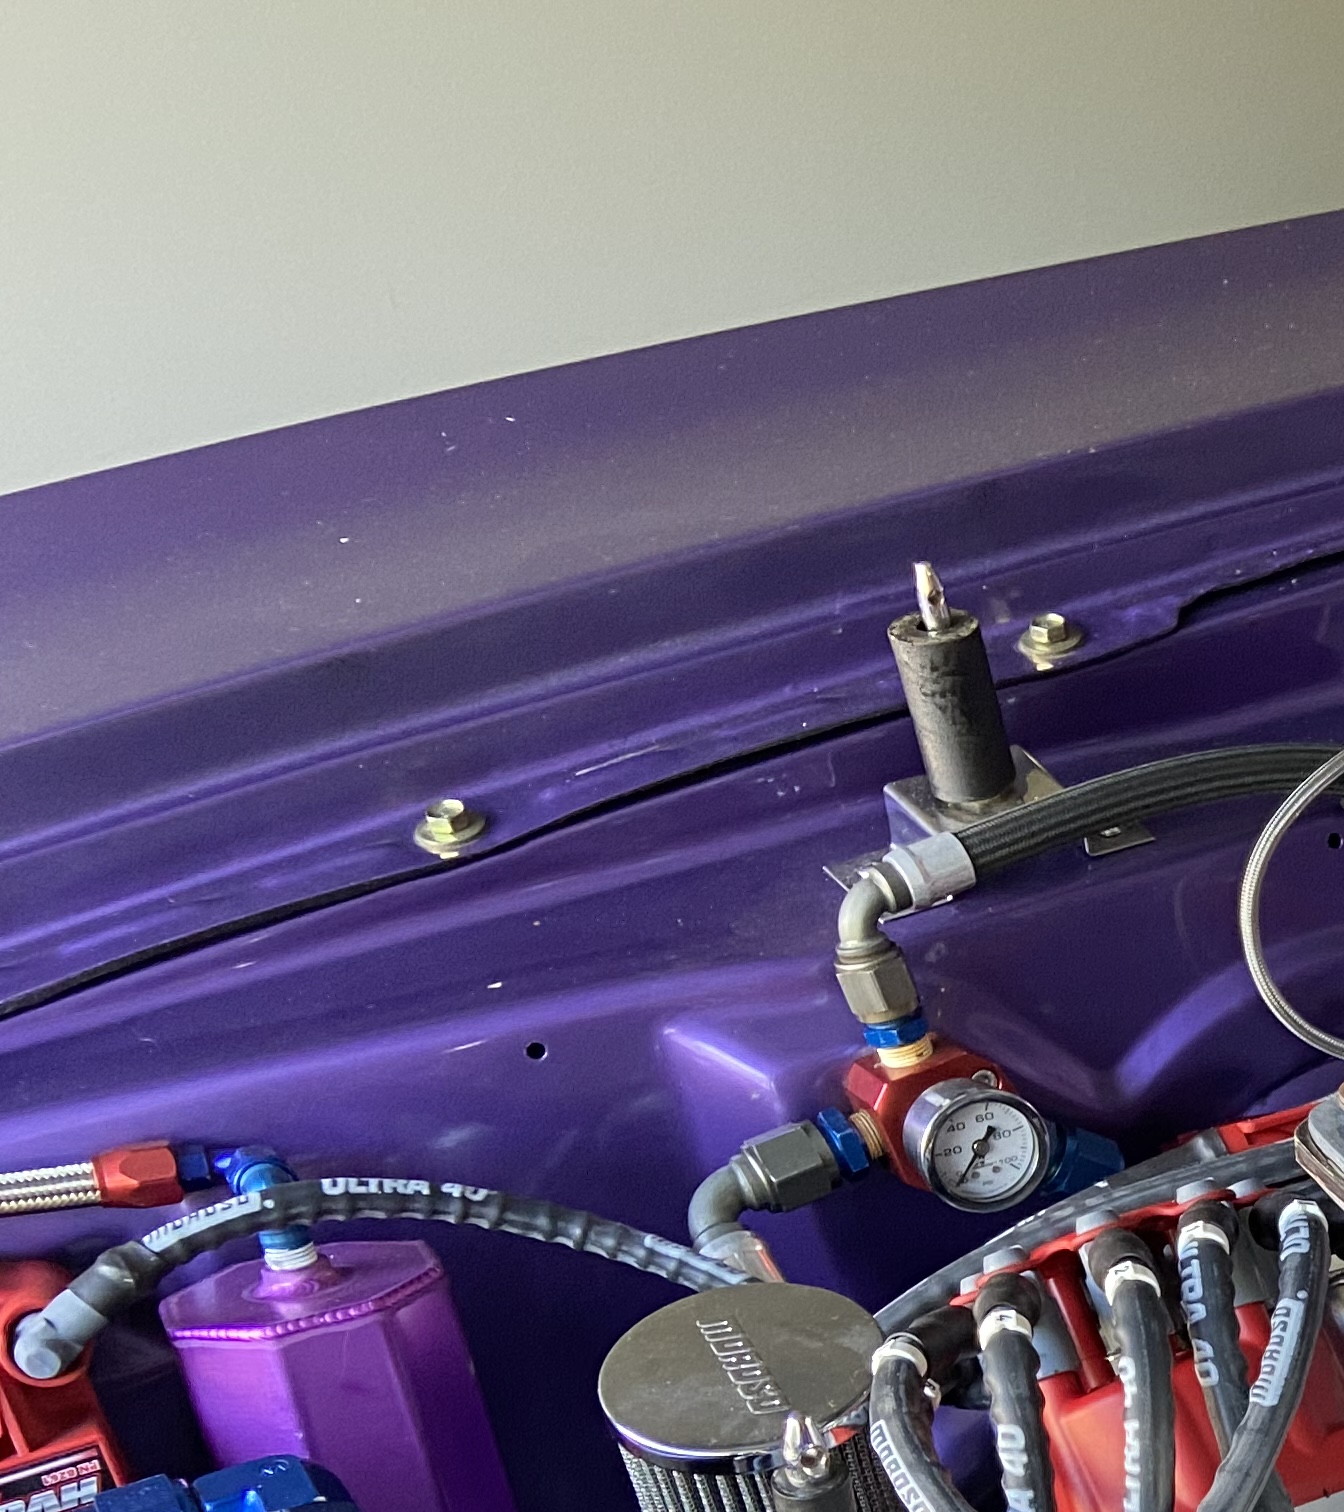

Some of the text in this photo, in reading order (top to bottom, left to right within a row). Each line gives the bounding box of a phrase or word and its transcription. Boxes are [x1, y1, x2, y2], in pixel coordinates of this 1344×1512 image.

[975, 1111, 994, 1123] 60
[946, 1122, 966, 1133] 40
[944, 1146, 963, 1158] 20
